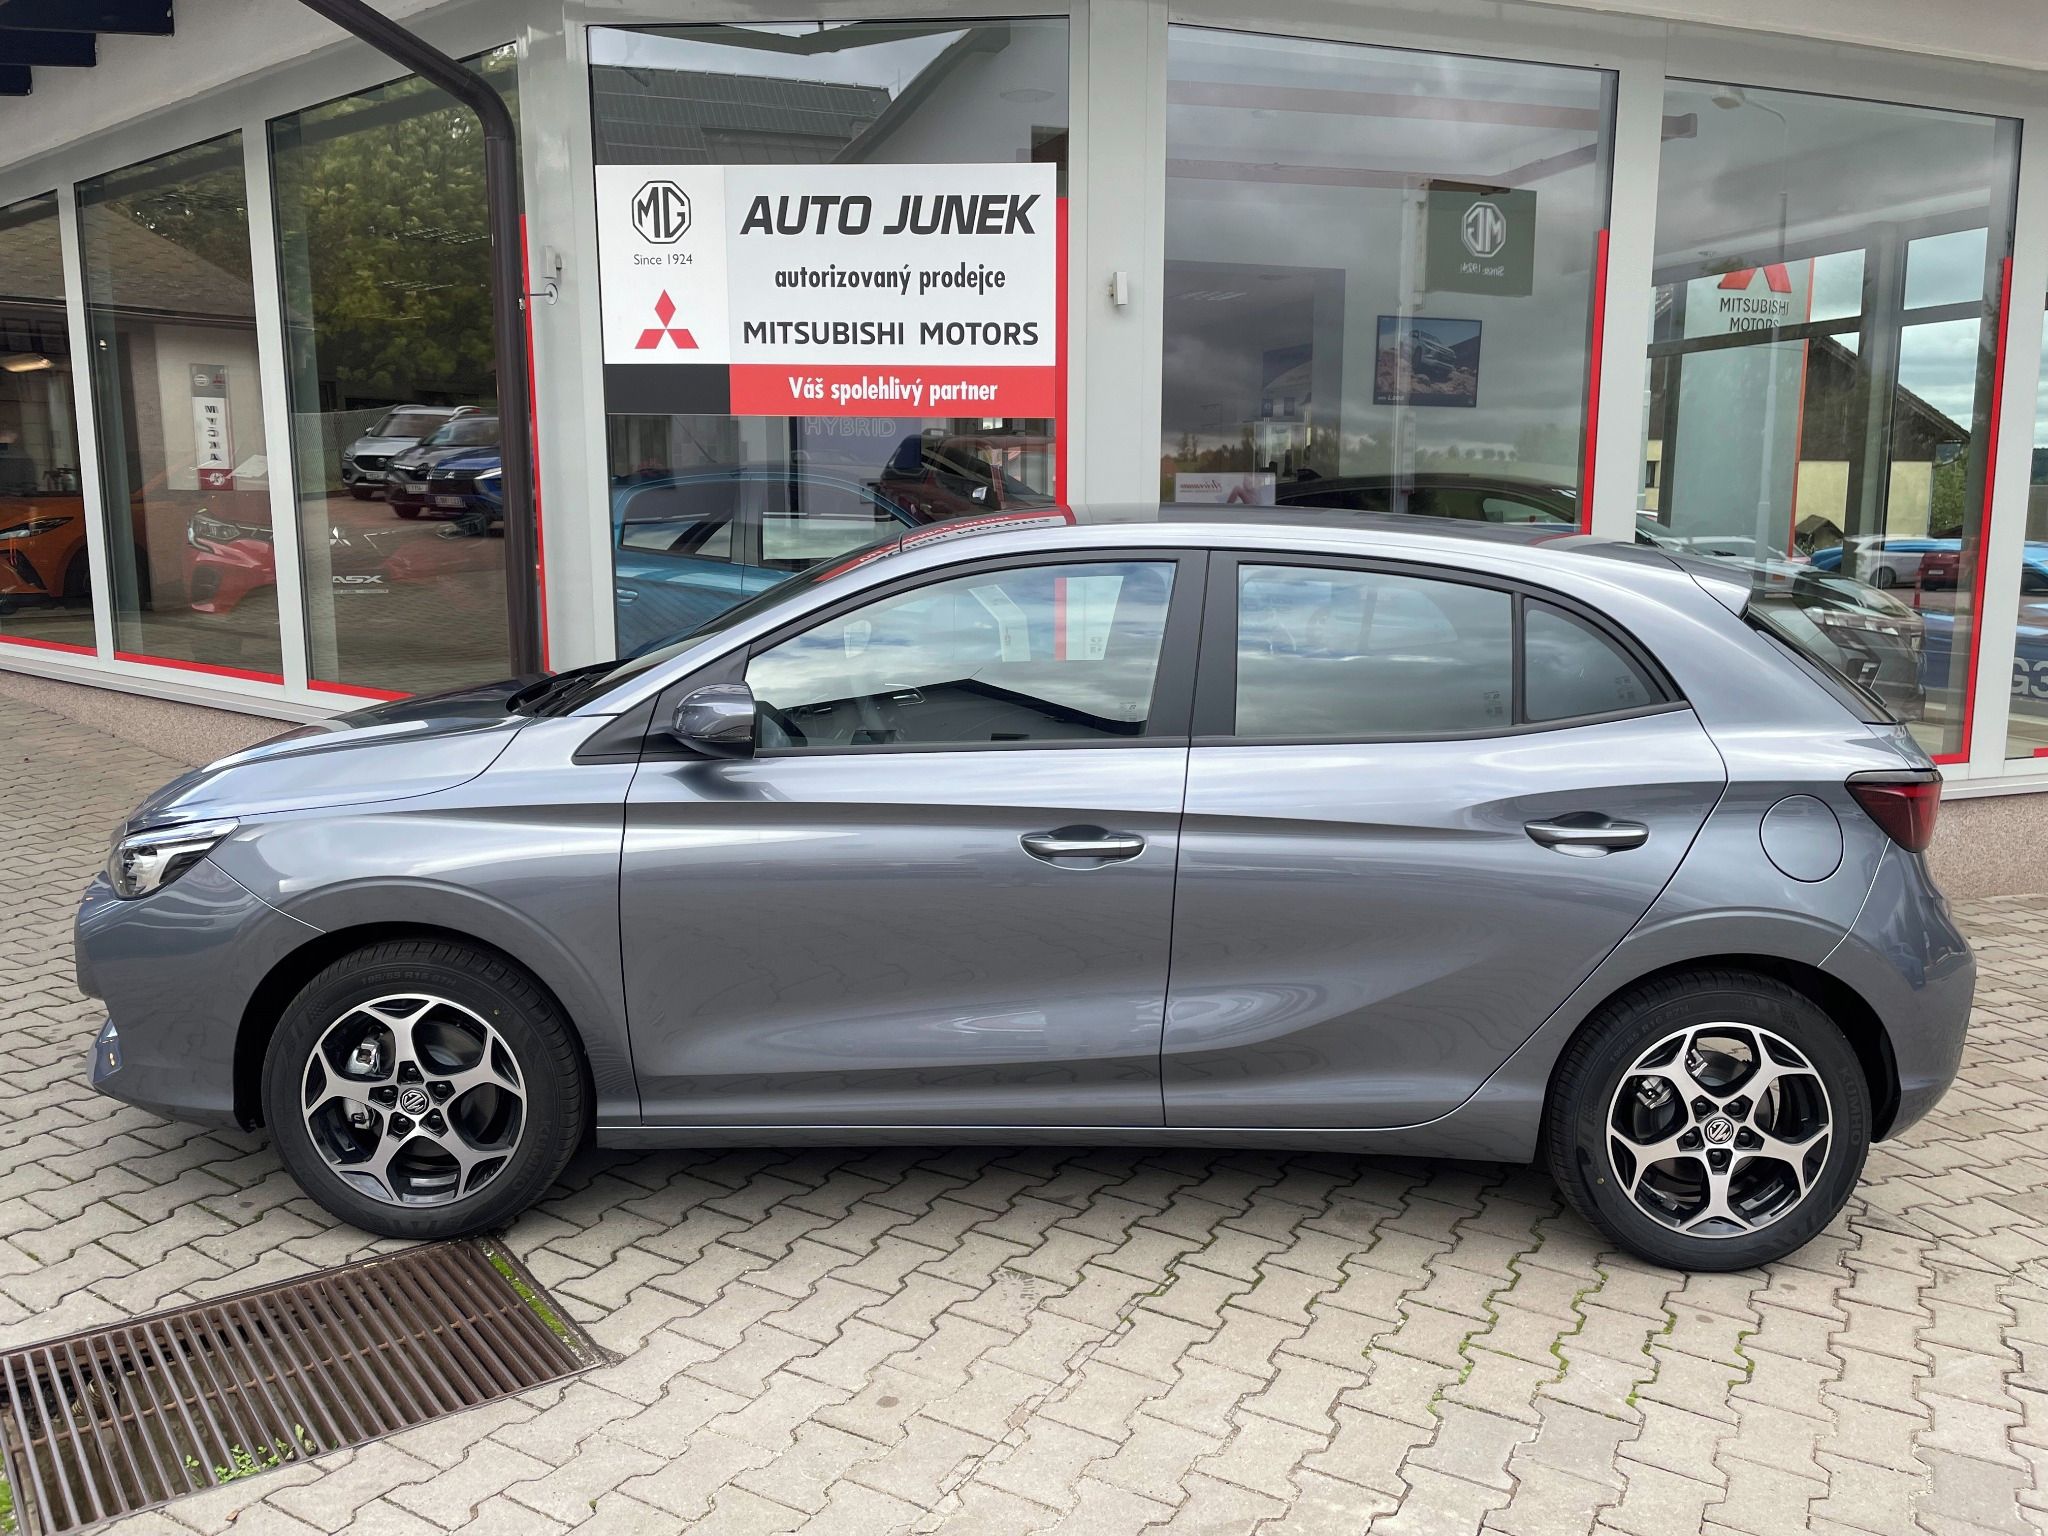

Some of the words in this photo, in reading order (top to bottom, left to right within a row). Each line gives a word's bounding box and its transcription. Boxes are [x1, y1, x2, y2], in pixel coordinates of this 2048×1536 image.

[634, 184, 689, 241] MG
[740, 194, 872, 235] AUTO
[883, 193, 1041, 235] JUNEK
[633, 253, 662, 266] Since
[666, 252, 693, 265] 1924
[775, 264, 911, 296] autorizovaný
[919, 262, 1006, 296] prodejce
[1719, 297, 1790, 316] MITSUBISHI
[743, 321, 904, 346] MITSUBISHI
[920, 321, 1039, 346] MOTORS
[788, 374, 825, 400] Váš
[830, 376, 923, 407] spolehlivý
[929, 381, 998, 407] partner
[804, 416, 897, 438] HYBRID
[332, 575, 384, 584] ASX
[1838, 1066, 1862, 1145] KUMHO
